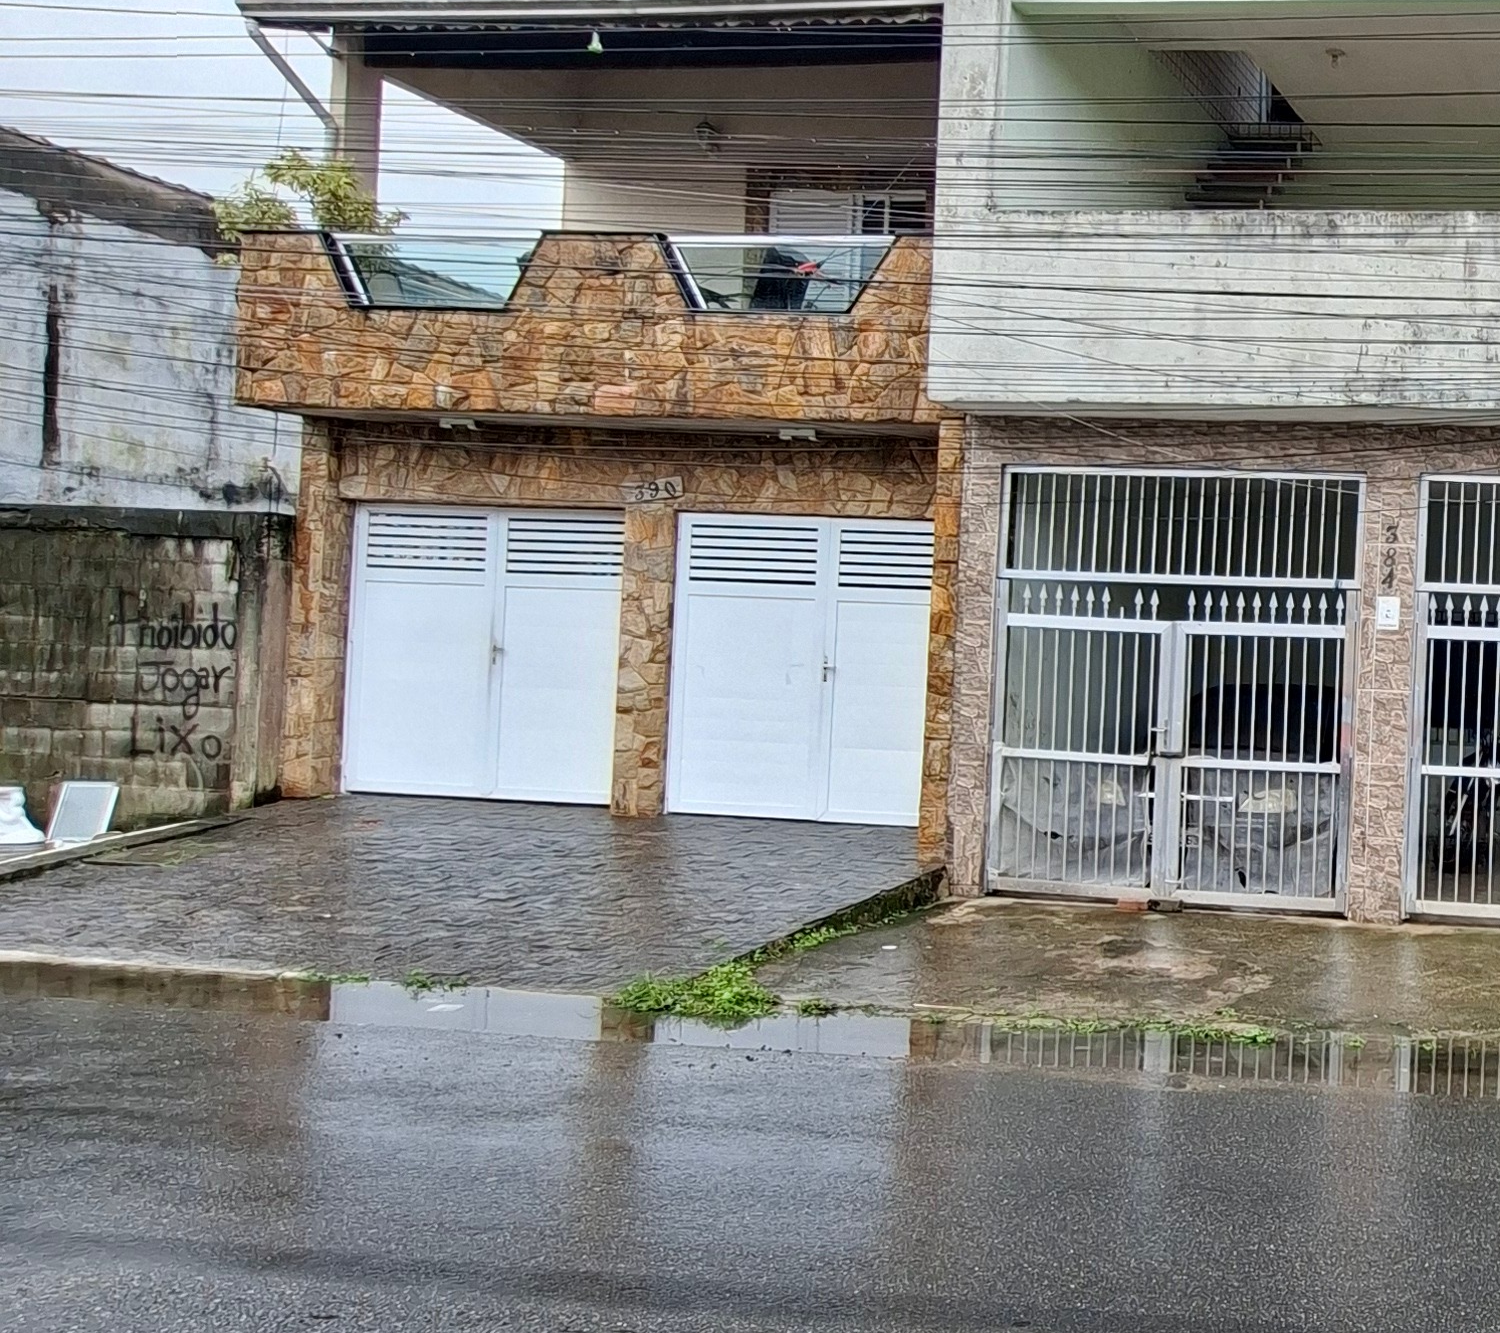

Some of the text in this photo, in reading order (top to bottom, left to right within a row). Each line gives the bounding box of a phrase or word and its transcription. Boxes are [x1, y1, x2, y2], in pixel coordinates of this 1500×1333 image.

[634, 481, 677, 501] 390
[1381, 520, 1400, 589] 384
[139, 660, 231, 720] Jogar
[130, 716, 222, 759] Lixo
